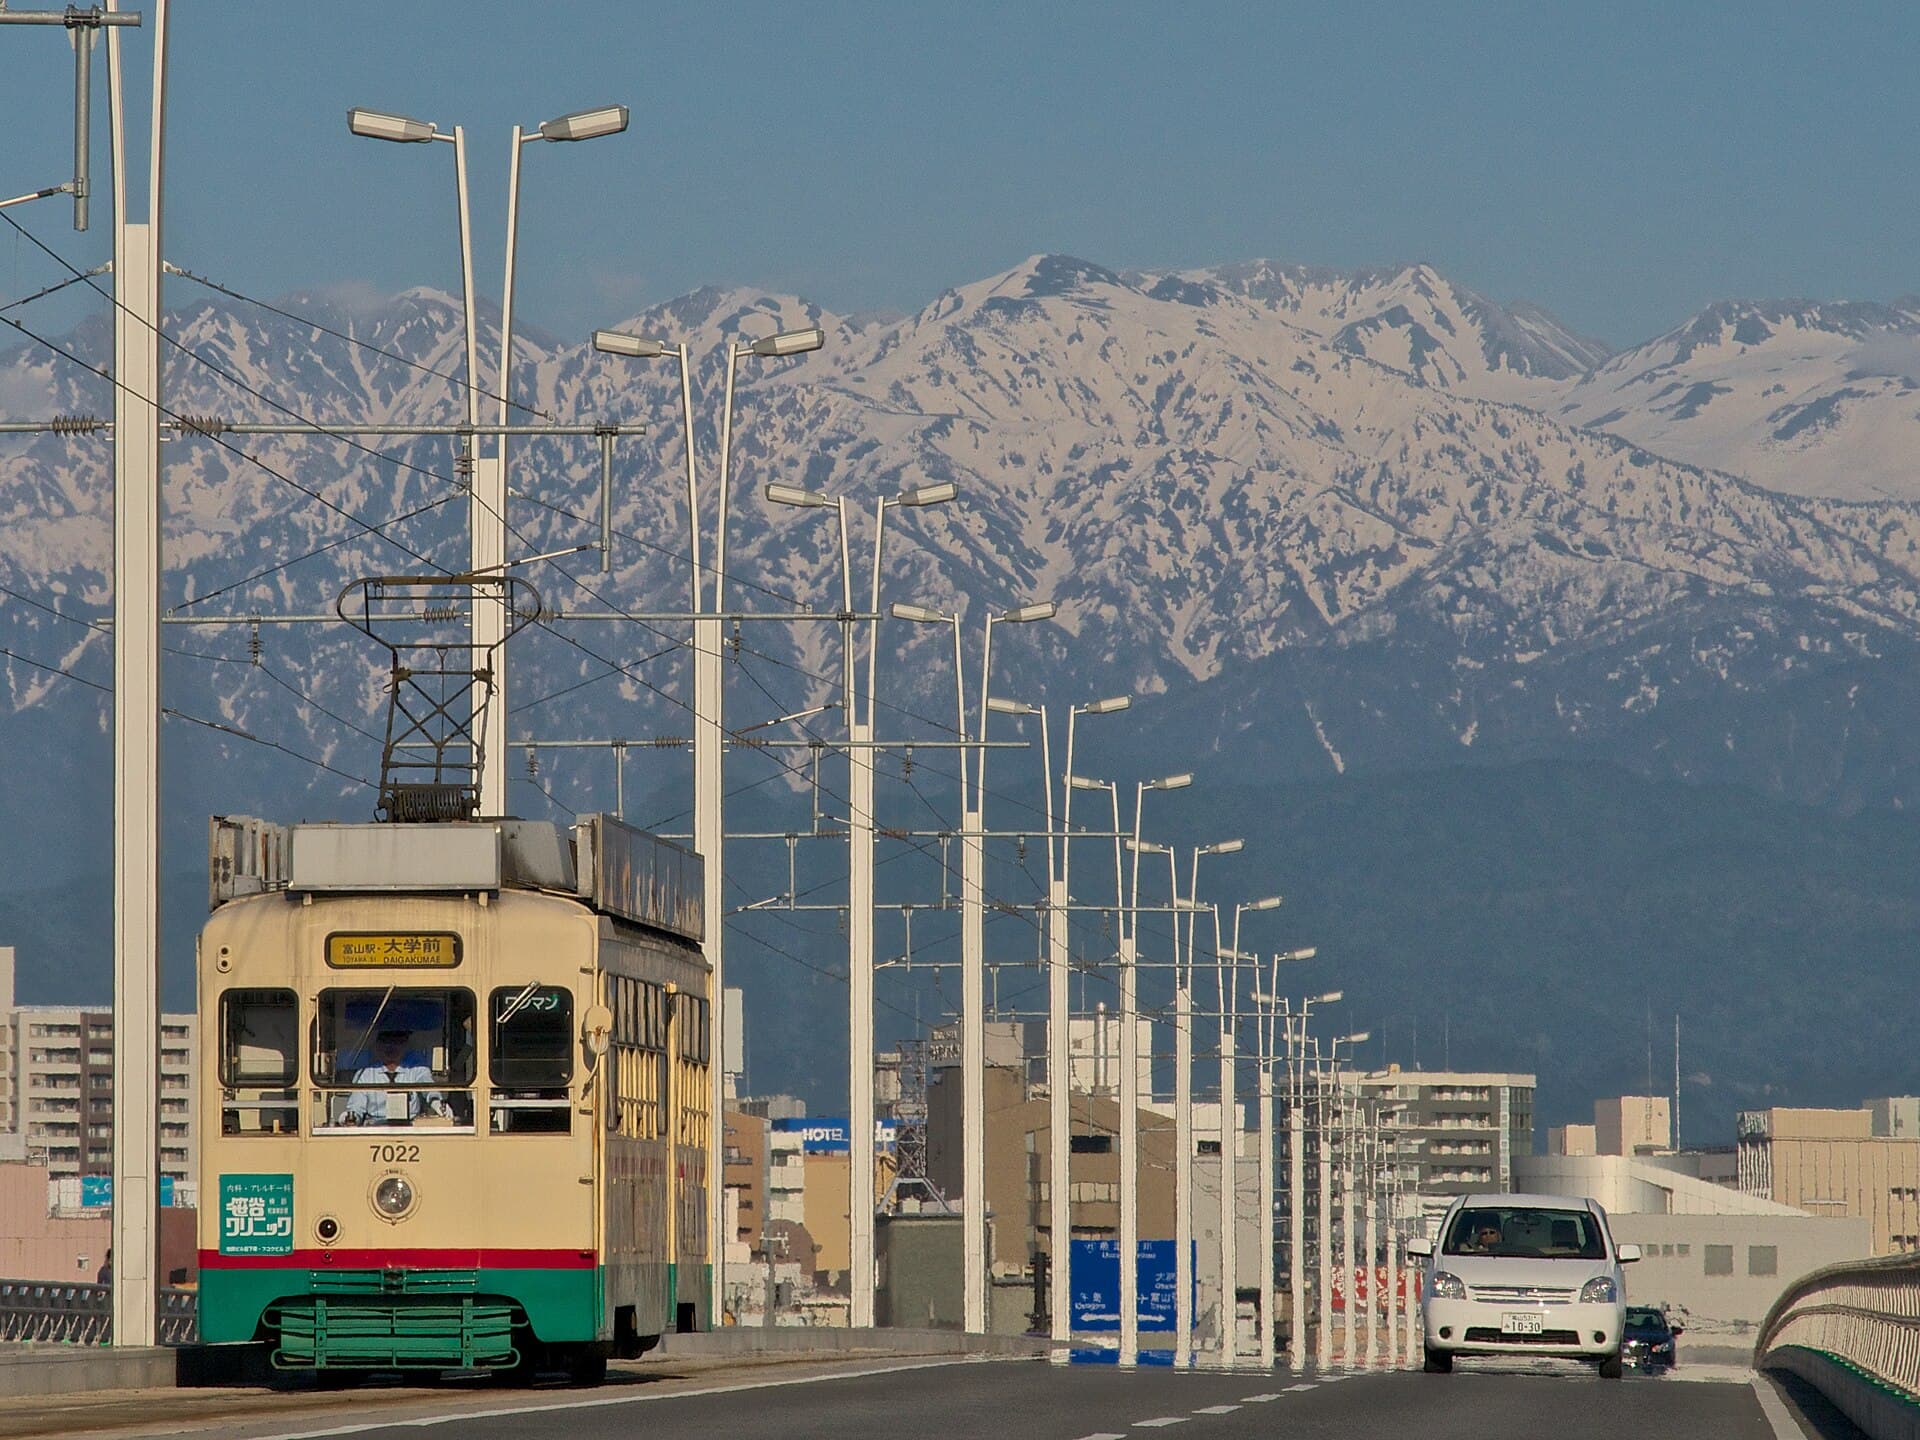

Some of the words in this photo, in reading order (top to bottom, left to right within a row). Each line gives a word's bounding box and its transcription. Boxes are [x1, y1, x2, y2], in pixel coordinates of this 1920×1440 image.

[383, 956, 441, 965] DAIGAKUMAE
[802, 1128, 849, 1142] HOTEL
[369, 1145, 420, 1163] 7022
[225, 1217, 292, 1236] クリニック
[1512, 1322, 1541, 1333] 10-30
